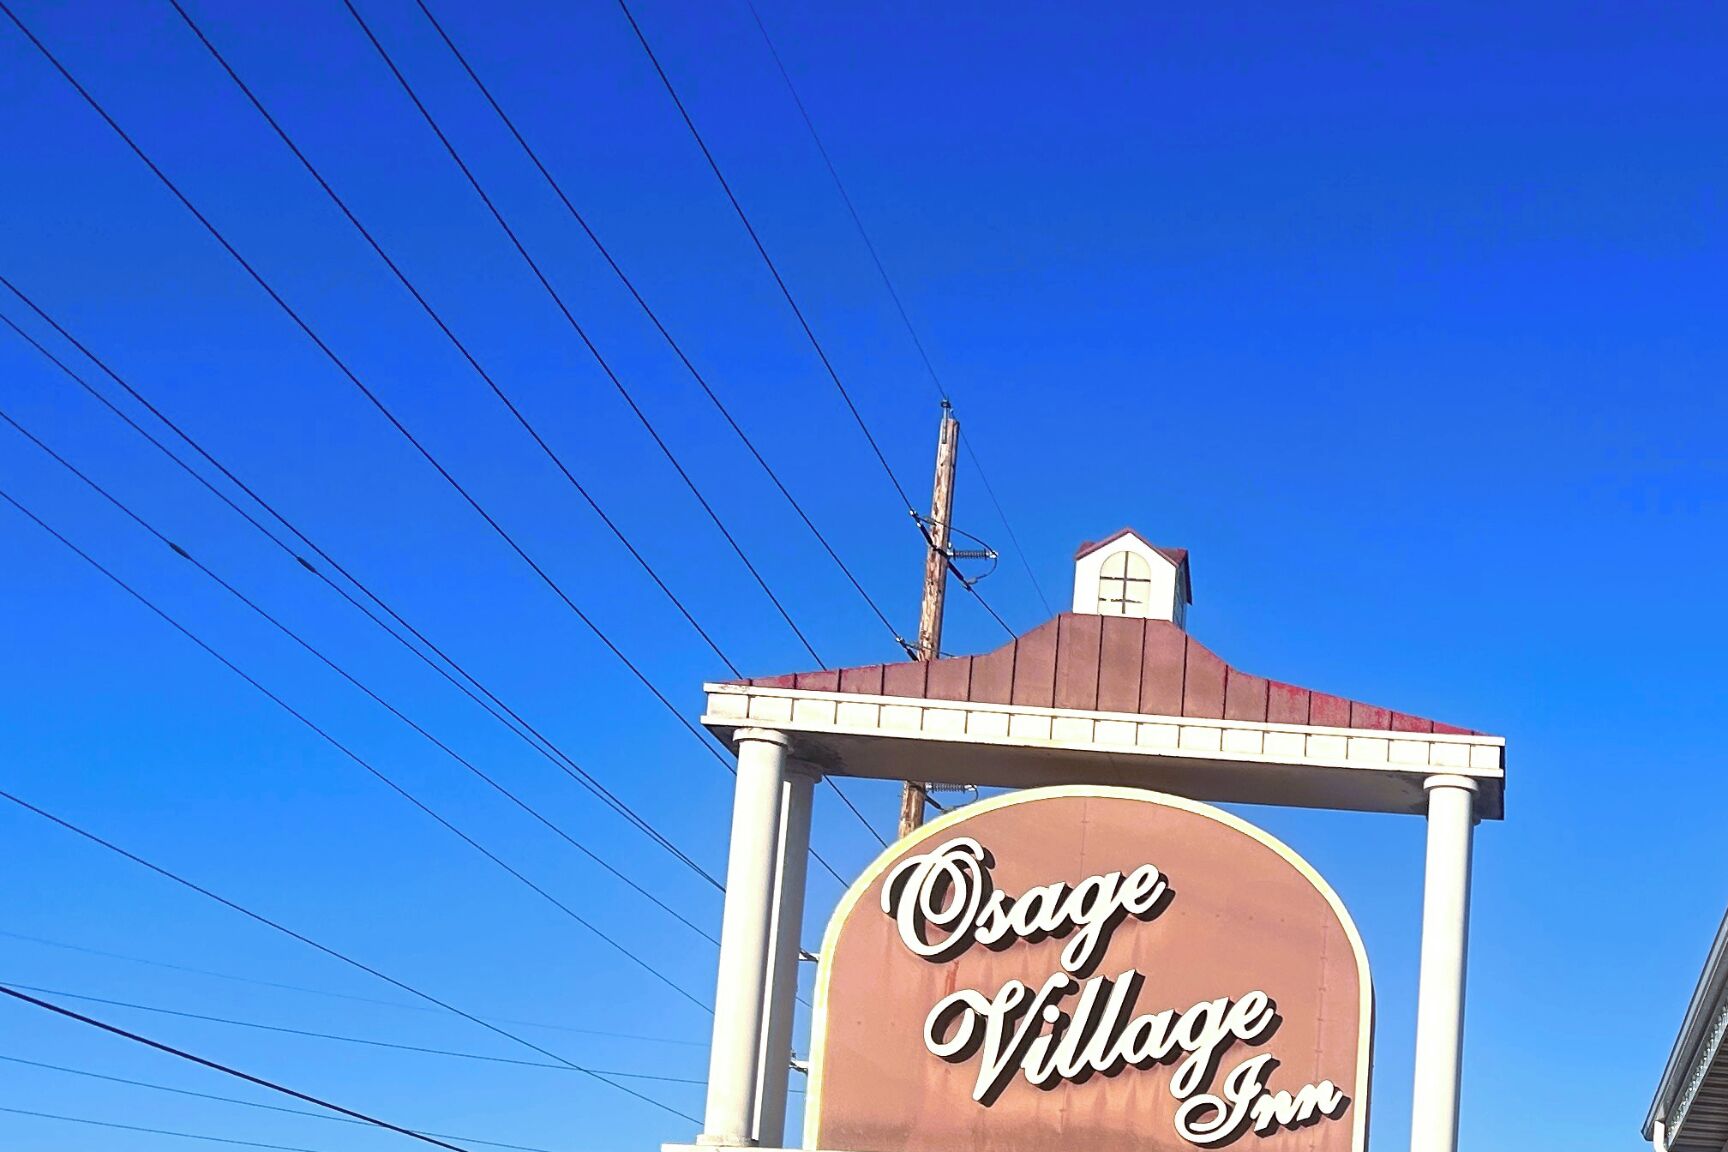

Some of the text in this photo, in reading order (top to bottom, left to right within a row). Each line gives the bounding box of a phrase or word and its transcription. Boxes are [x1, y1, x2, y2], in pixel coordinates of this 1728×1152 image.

[880, 836, 1170, 974] Osage
[923, 969, 1278, 1103] Village
[1173, 1053, 1344, 1146] Inn
